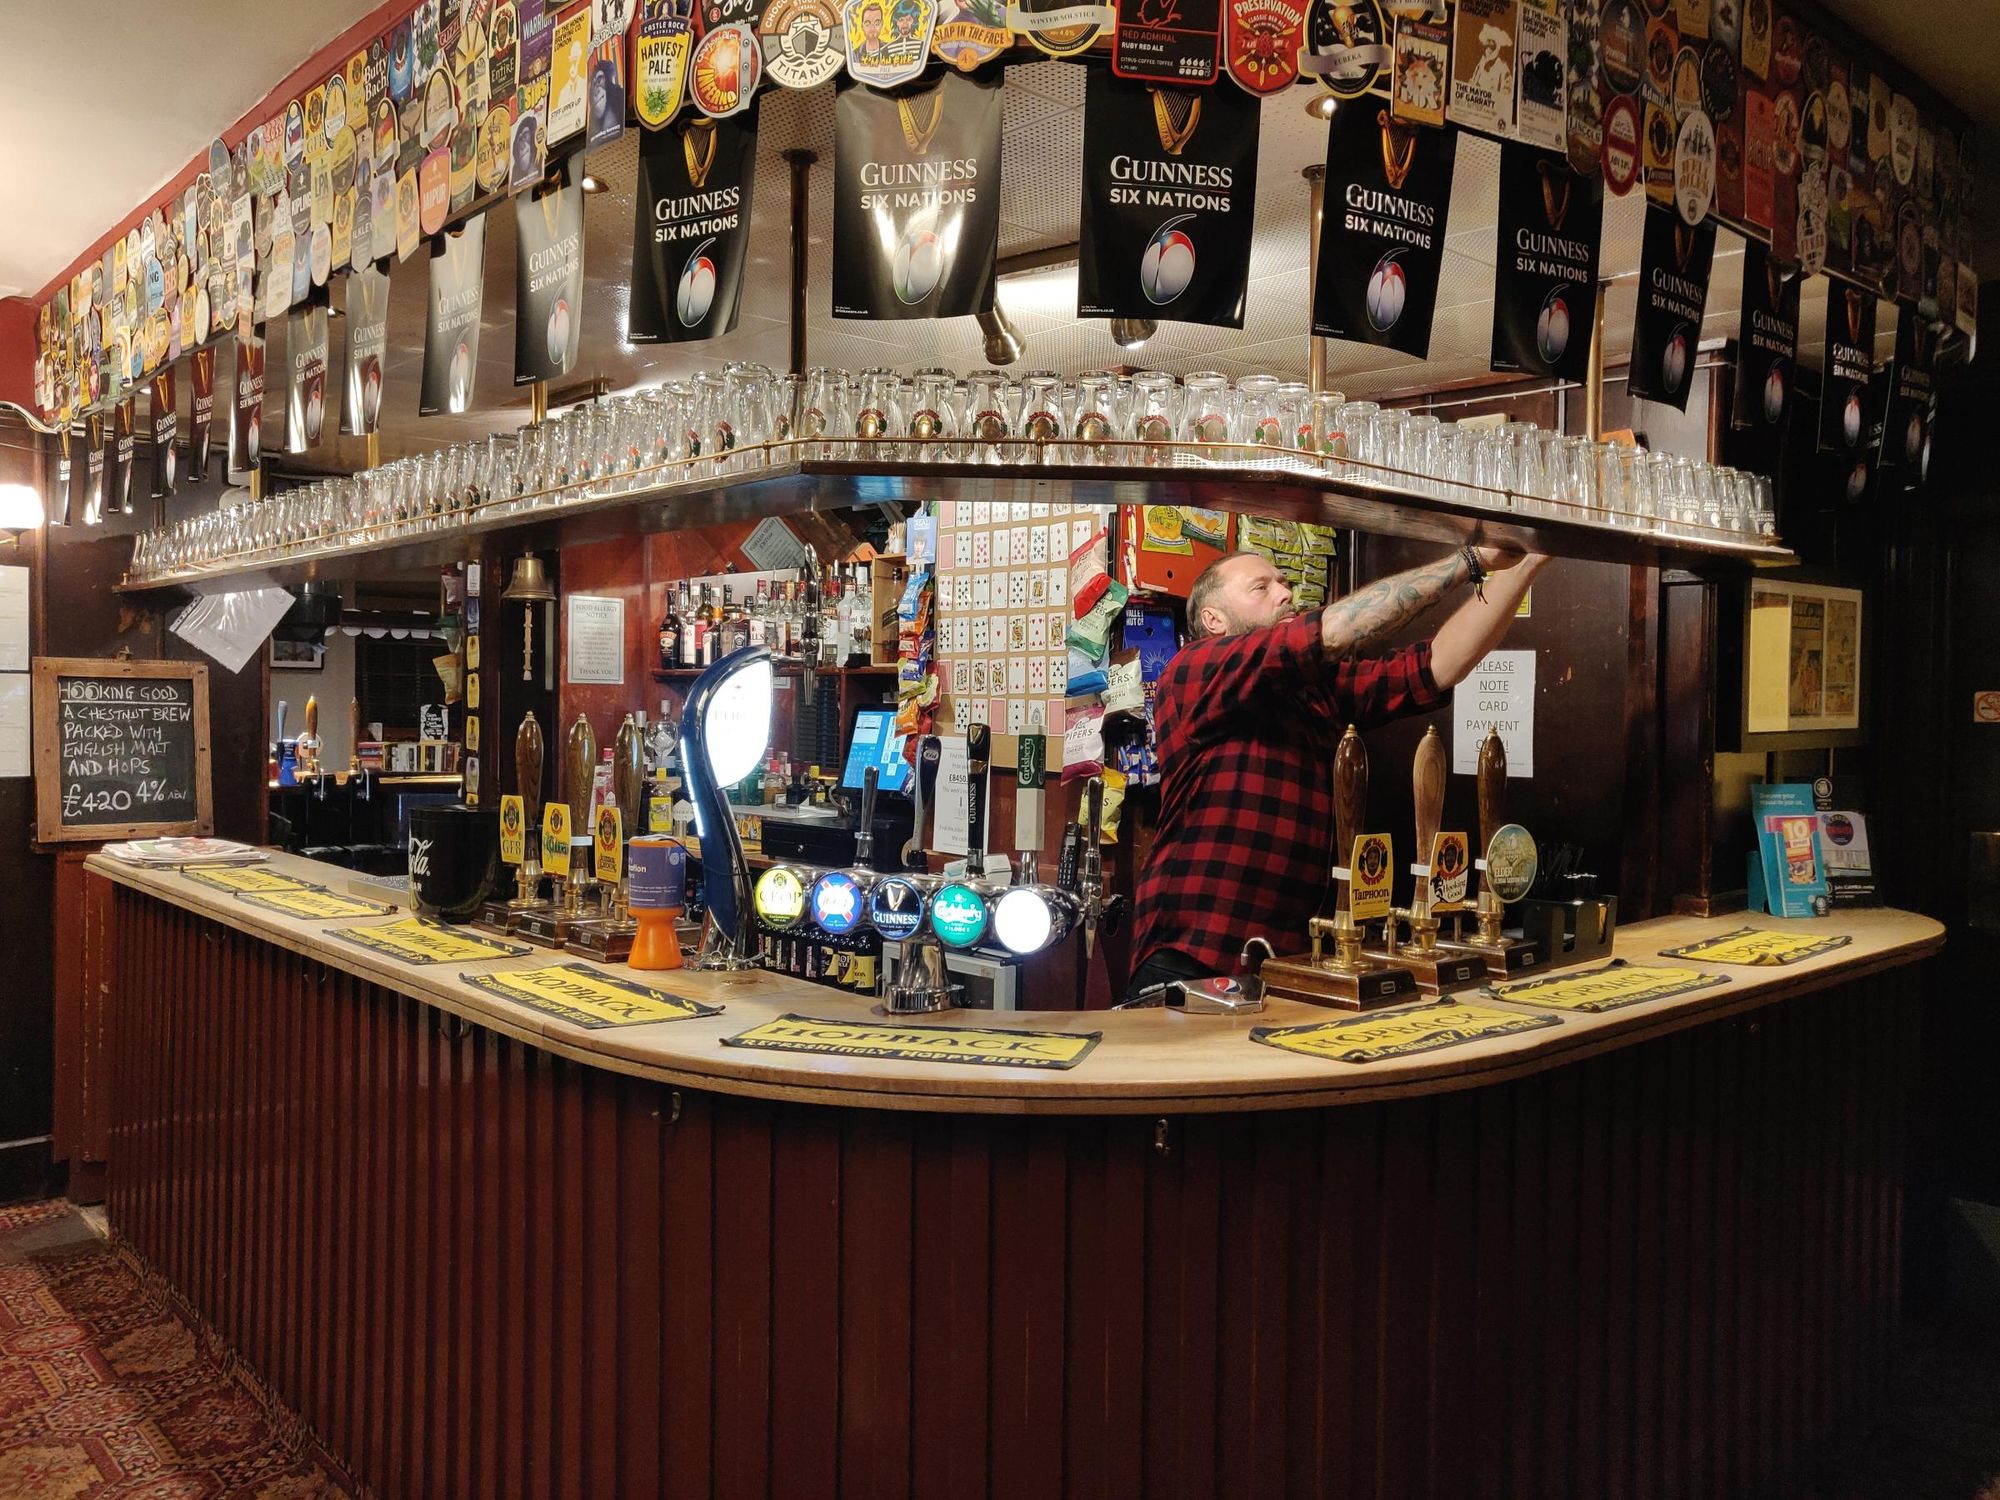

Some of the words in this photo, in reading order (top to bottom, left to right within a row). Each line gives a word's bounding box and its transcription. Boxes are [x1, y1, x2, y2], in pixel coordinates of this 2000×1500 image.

[1030, 15, 1059, 25] WINTER
[1060, 11, 1096, 21] SOLSTICE
[1234, 0, 1303, 27] PRESERVATION
[643, 22, 668, 34] CASTLE
[668, 22, 685, 31] ROCK
[934, 27, 955, 41] SLAP
[957, 26, 965, 36] IN
[968, 27, 984, 40] THE
[984, 30, 1005, 44] FACE
[1122, 30, 1140, 39] RED
[1141, 31, 1177, 43] ADMIRAL
[641, 41, 684, 62] HARVEST
[1121, 42, 1138, 50] RUBY
[1139, 43, 1150, 51] RED
[1151, 44, 1164, 52] ALE
[1334, 52, 1362, 66] EUREKA
[364, 54, 389, 84] Butty
[648, 58, 672, 76] PALE
[776, 54, 836, 80] TITANIC
[364, 74, 389, 102] Bach
[1455, 83, 1468, 92] THE
[1469, 86, 1492, 100] MAYOR
[1455, 91, 1464, 99] OF
[1465, 93, 1496, 109] GARRATT
[861, 158, 978, 187] GUINNESS
[1110, 155, 1233, 189] GUINNESS
[655, 186, 740, 221] GUINNESS
[861, 193, 889, 210] SIX
[895, 188, 977, 208] NATIONS
[1110, 188, 1141, 206] SIX
[1146, 190, 1231, 213] NATIONS
[1345, 183, 1435, 228] GUINNESS
[655, 225, 678, 243] SIX
[680, 214, 739, 239] NATIONS
[1345, 214, 1369, 234] SIX
[1373, 220, 1432, 250] NATIONS
[529, 232, 579, 273] GUINNESS
[1516, 228, 1589, 263] GUINNESS
[530, 278, 545, 293] SIX
[545, 257, 579, 287] NATIONS
[1516, 257, 1536, 273] SIX
[1539, 263, 1588, 284] NATIONS
[1652, 267, 1704, 305] GUINNESS
[438, 285, 480, 316] GUINNESS
[1652, 294, 1666, 310] SIX
[1668, 299, 1700, 324] NATIONS
[353, 321, 386, 345] GUINNESS
[438, 320, 451, 334] SIX
[450, 310, 479, 330] NATIONS
[1752, 309, 1794, 341] GUINNESS
[295, 342, 327, 370] GUINNESS
[353, 347, 365, 360] SIX
[364, 340, 385, 357] NATIONS
[1752, 334, 1765, 346] SIX
[1766, 338, 1793, 358] NATIONS
[296, 371, 306, 384] SIX
[306, 361, 327, 380] NATIONS
[1476, 661, 1515, 672] PLEASE
[59, 681, 135, 701] HOOKING
[140, 684, 178, 701] GOOD
[1479, 680, 1509, 691] NOTE
[64, 707, 74, 719] A
[77, 706, 150, 722] CHESTNUT
[152, 707, 191, 722] BREW
[1479, 701, 1509, 712] CARD
[64, 722, 123, 741] PACKED
[129, 724, 162, 742] WITH
[1065, 727, 1094, 740] PIPERS
[1466, 720, 1520, 731] PAYMENT
[63, 742, 125, 758] ENGLISH
[130, 741, 172, 755] MALT
[1018, 737, 1036, 785] Carlsberg
[68, 759, 103, 777] AND
[107, 757, 151, 776] HOPS
[135, 778, 167, 803] 4%
[968, 782, 977, 824] GUINNESS
[1782, 820, 1809, 840] 10
[502, 839, 522, 855] GFB
[1443, 879, 1466, 893] Hooking
[1447, 888, 1463, 899] Good
[873, 911, 919, 925] GUINNESS
[513, 971, 654, 1019] HOPBACK
[763, 1025, 1065, 1056] HOPBACK
[1300, 1011, 1494, 1050] HOPBACK
[743, 1038, 893, 1057] REFRESHINGLY
[899, 1049, 976, 1064] HOPPY
[982, 1055, 1051, 1066] BEERS
